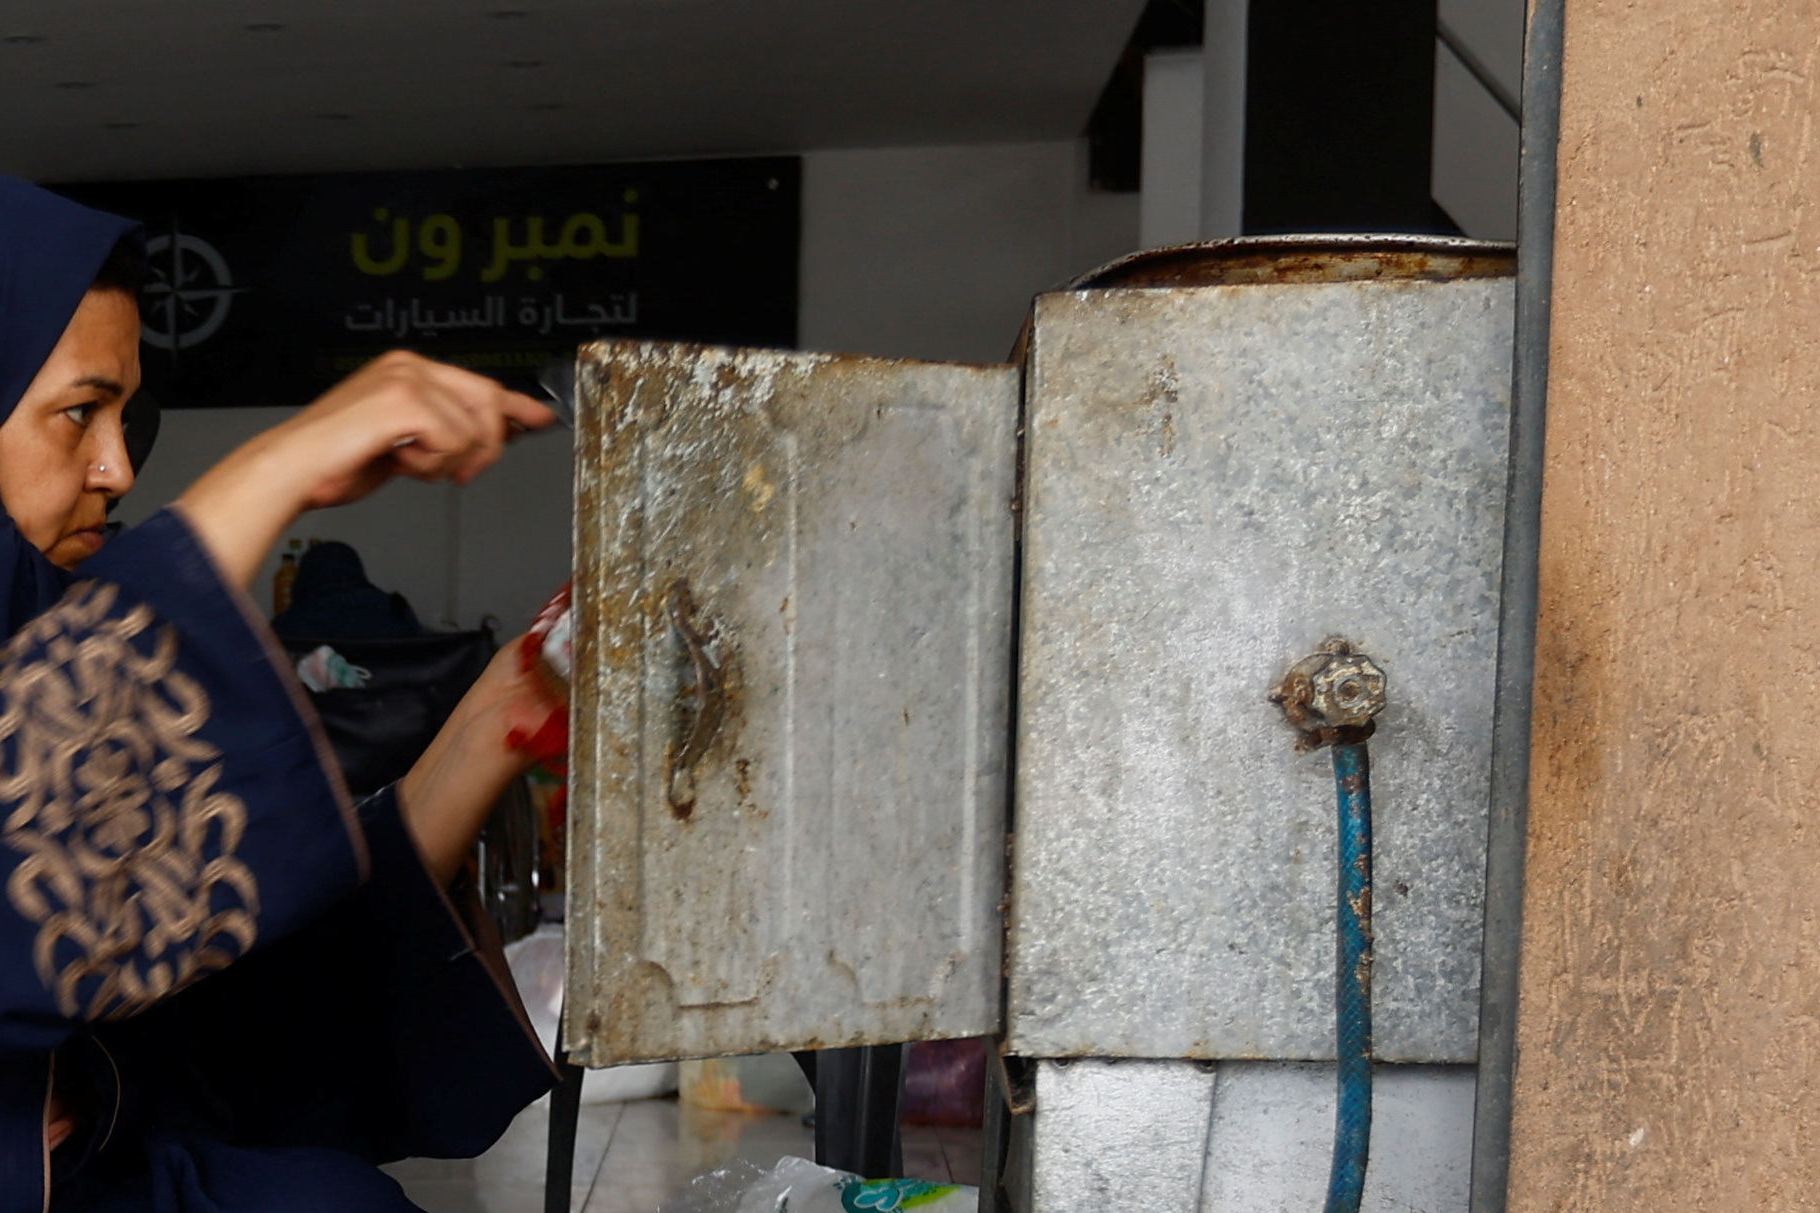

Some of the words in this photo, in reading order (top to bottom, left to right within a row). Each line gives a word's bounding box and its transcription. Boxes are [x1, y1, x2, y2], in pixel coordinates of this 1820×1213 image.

[480, 187, 640, 283] نمبر
[343, 293, 506, 338] السيارات
[517, 290, 639, 334] لتجارة
